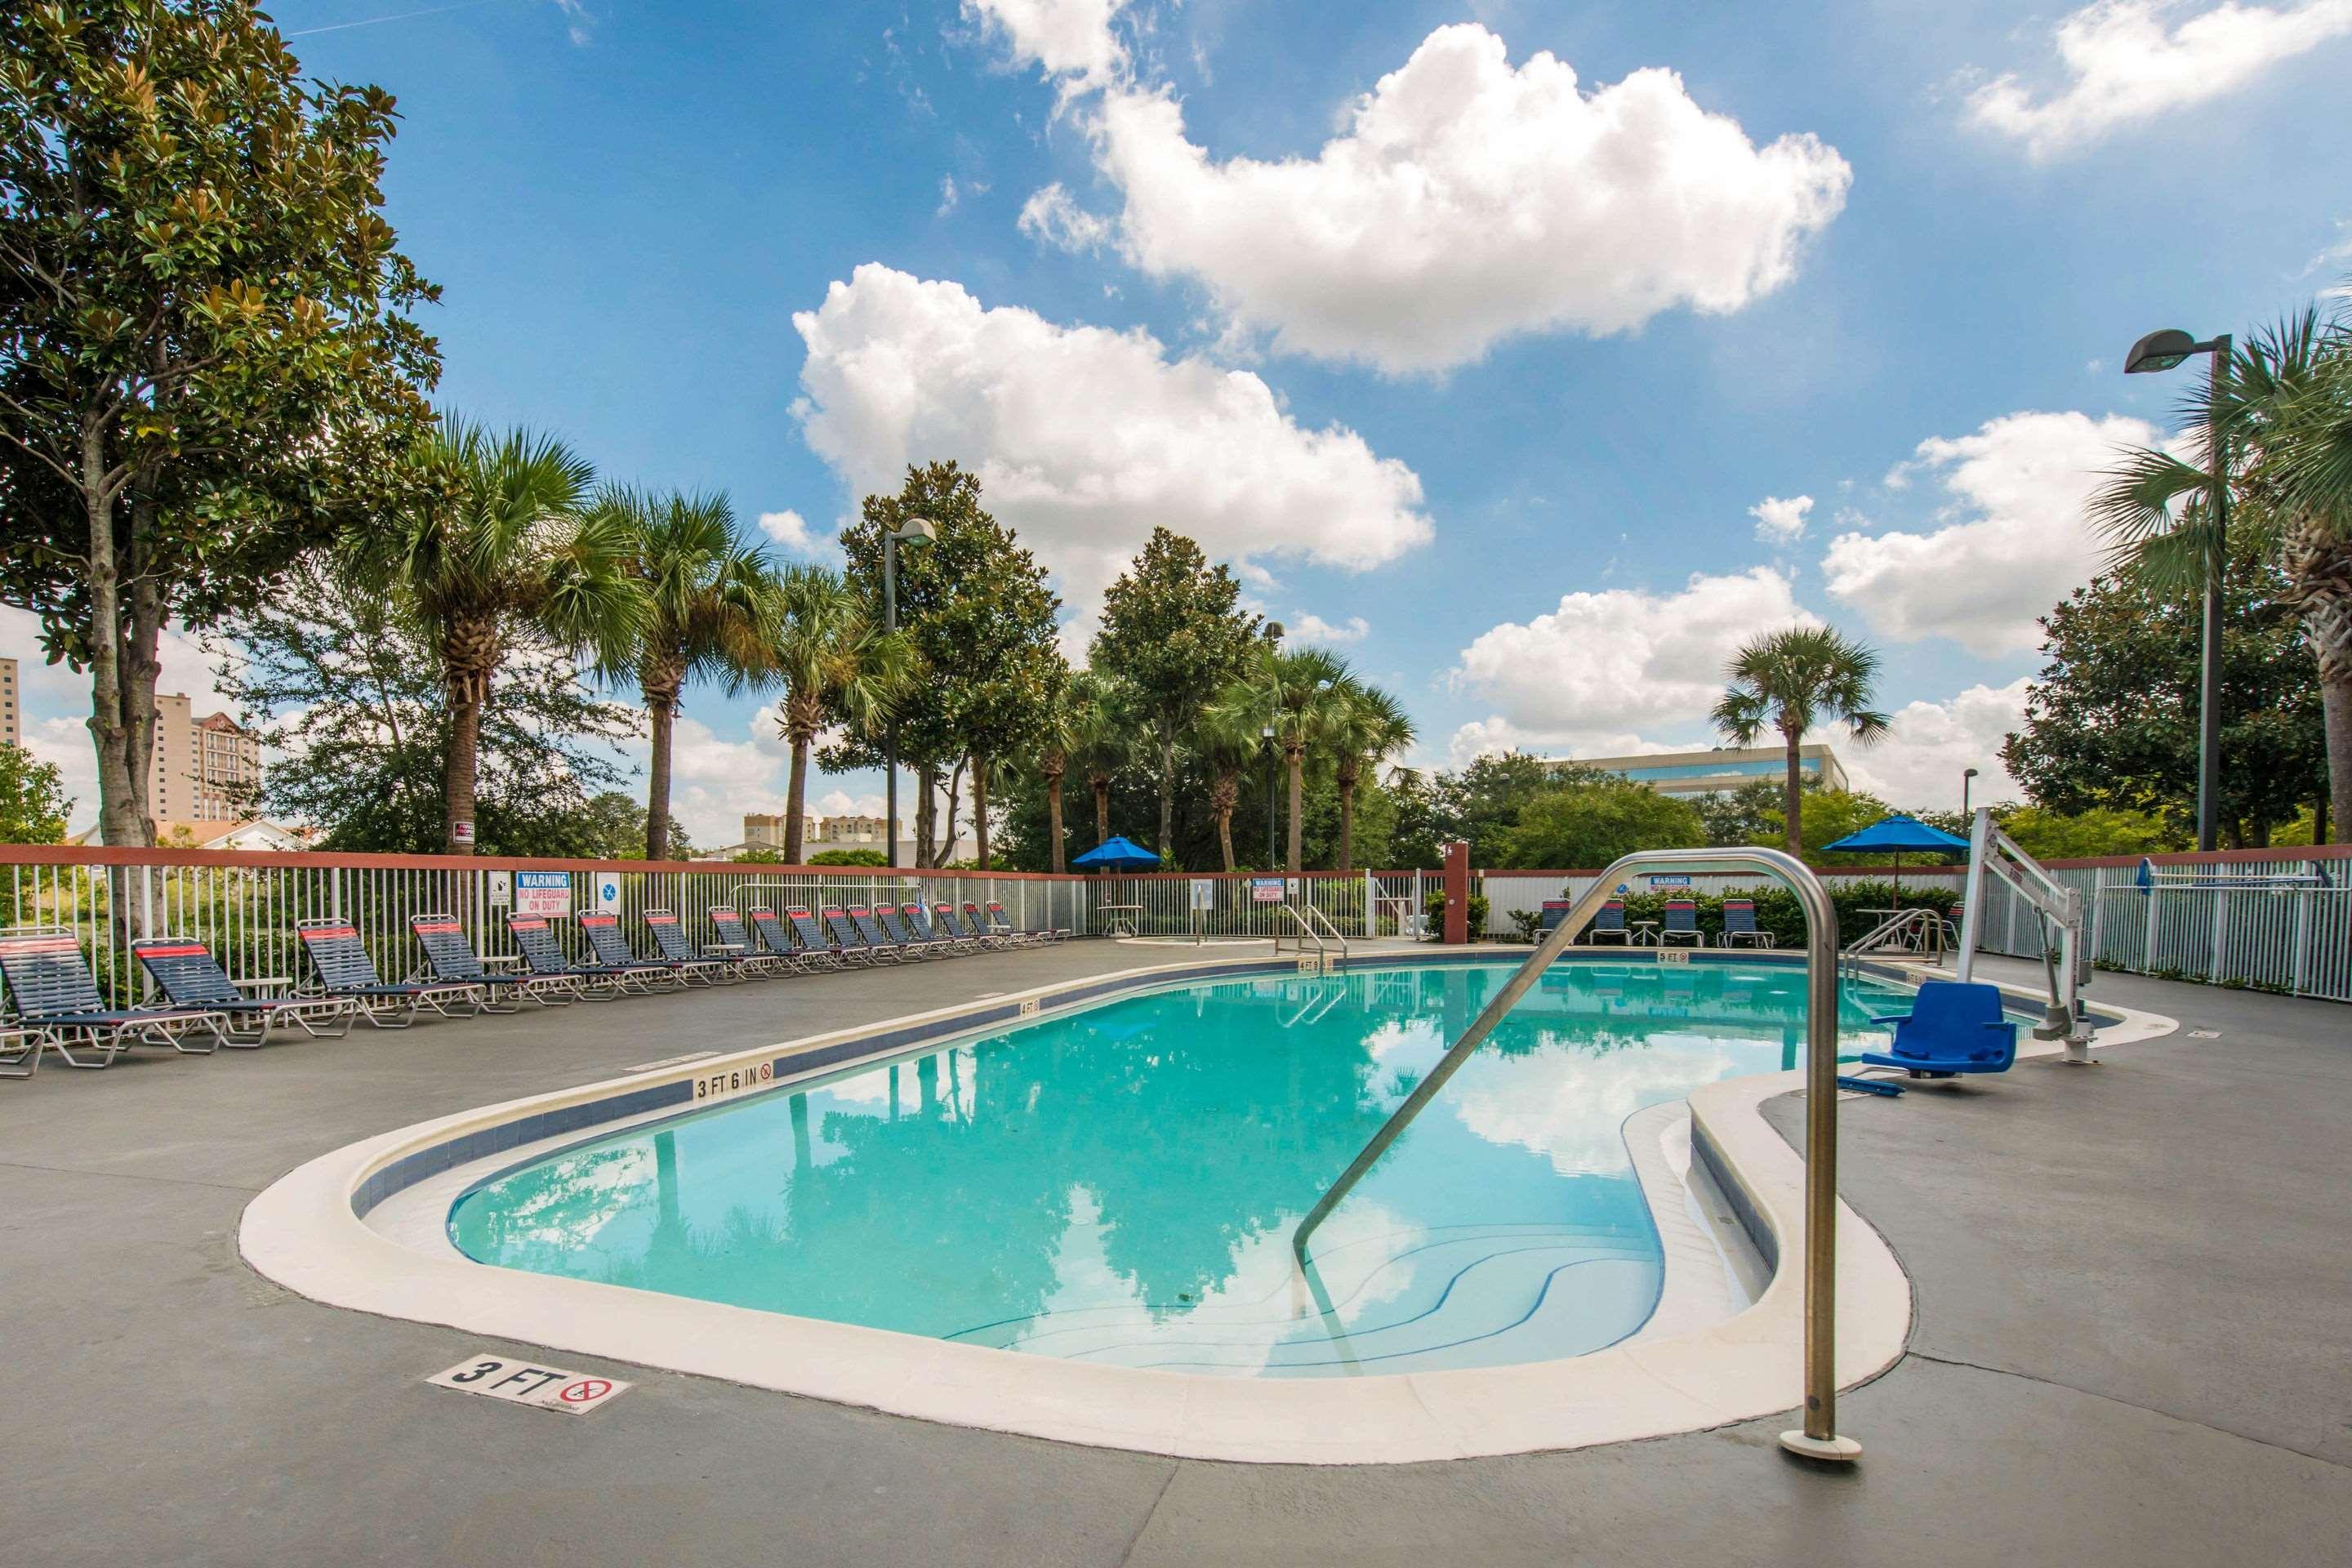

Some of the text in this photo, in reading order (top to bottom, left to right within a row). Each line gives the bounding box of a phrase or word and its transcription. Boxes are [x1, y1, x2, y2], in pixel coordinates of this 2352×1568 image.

[522, 874, 567, 887] WARNING
[519, 889, 529, 899] NO
[532, 889, 569, 899] LIFEGUARD
[529, 901, 560, 910] ON DUTY
[697, 1067, 757, 1098] 3 FT 6 IN
[452, 1361, 568, 1396] 3 FT
